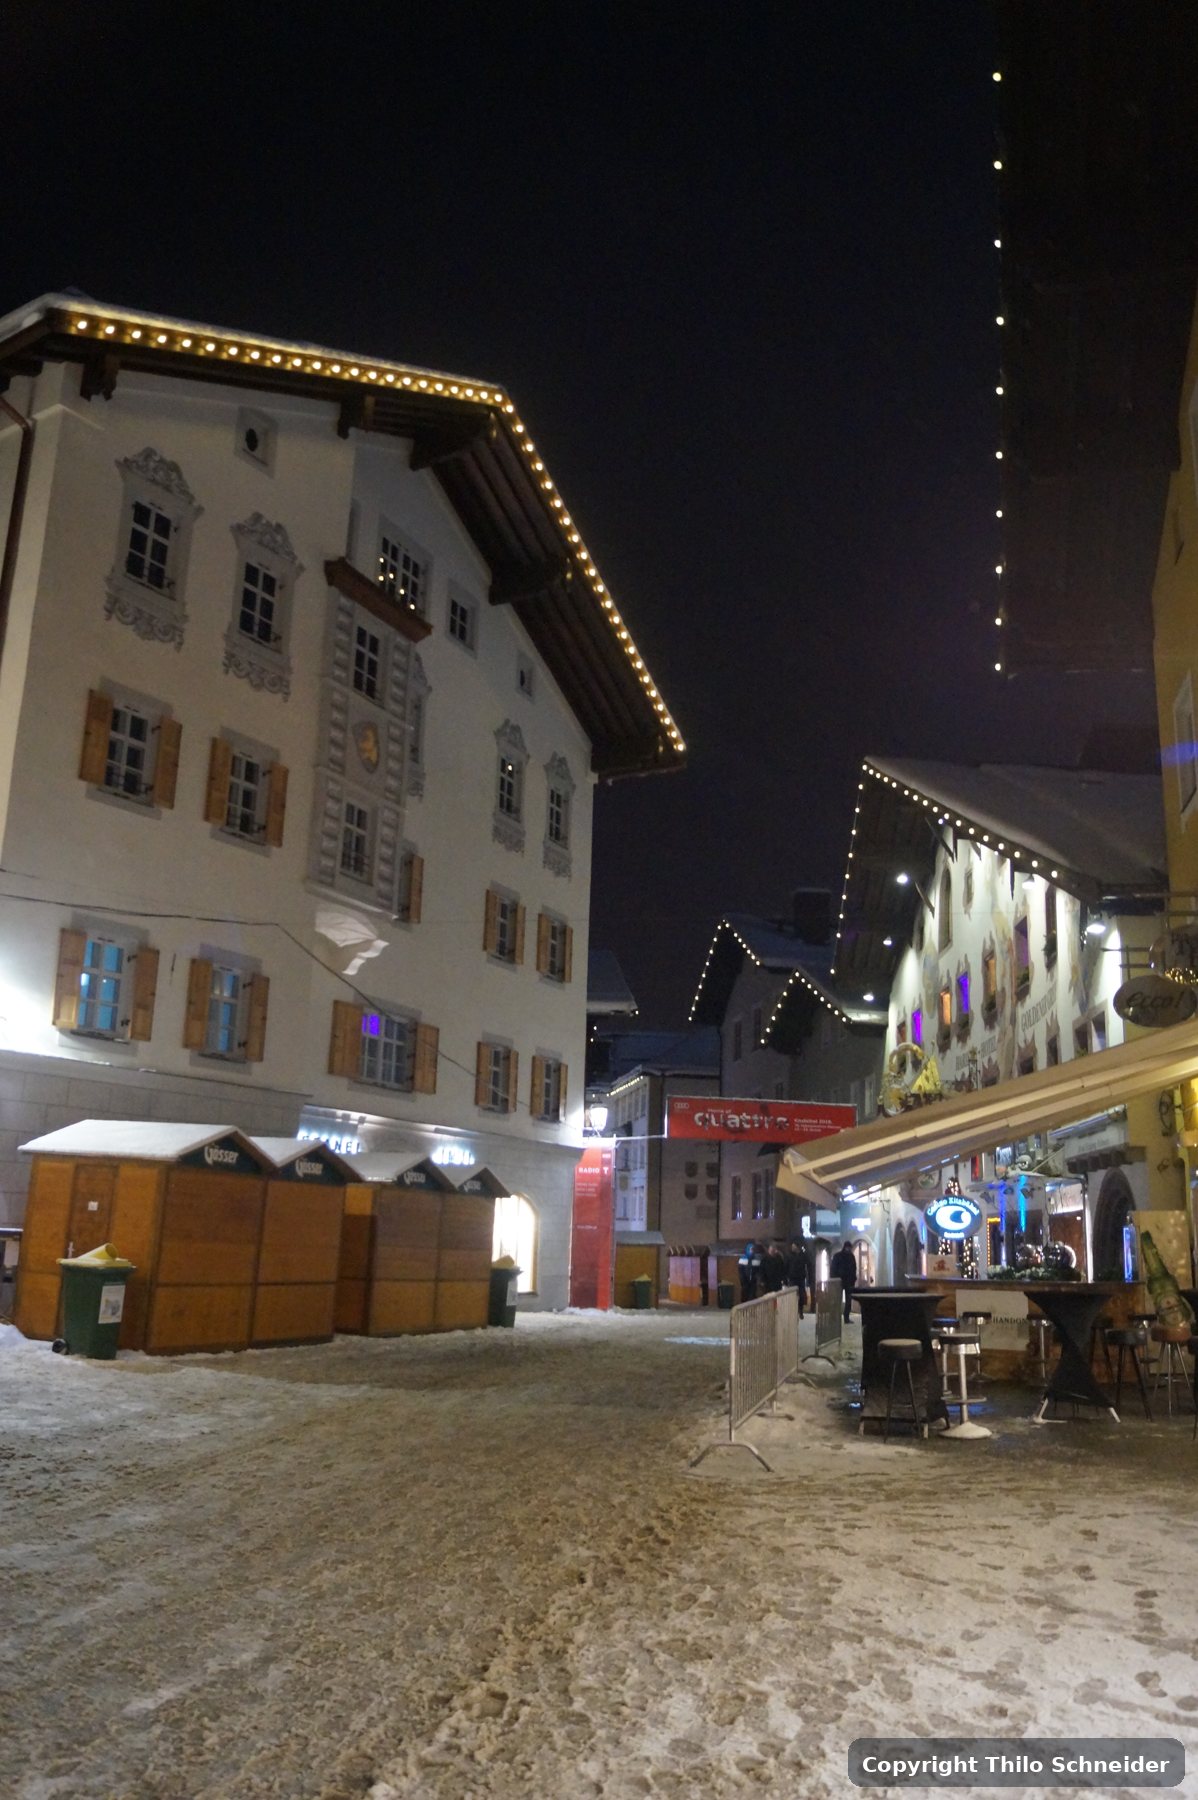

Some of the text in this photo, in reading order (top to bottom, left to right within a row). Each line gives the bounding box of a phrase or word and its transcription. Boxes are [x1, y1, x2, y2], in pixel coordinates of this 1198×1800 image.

[693, 1111, 790, 1131] quattro
[204, 1143, 239, 1165] Gösser
[578, 1167, 600, 1175] RADIO
